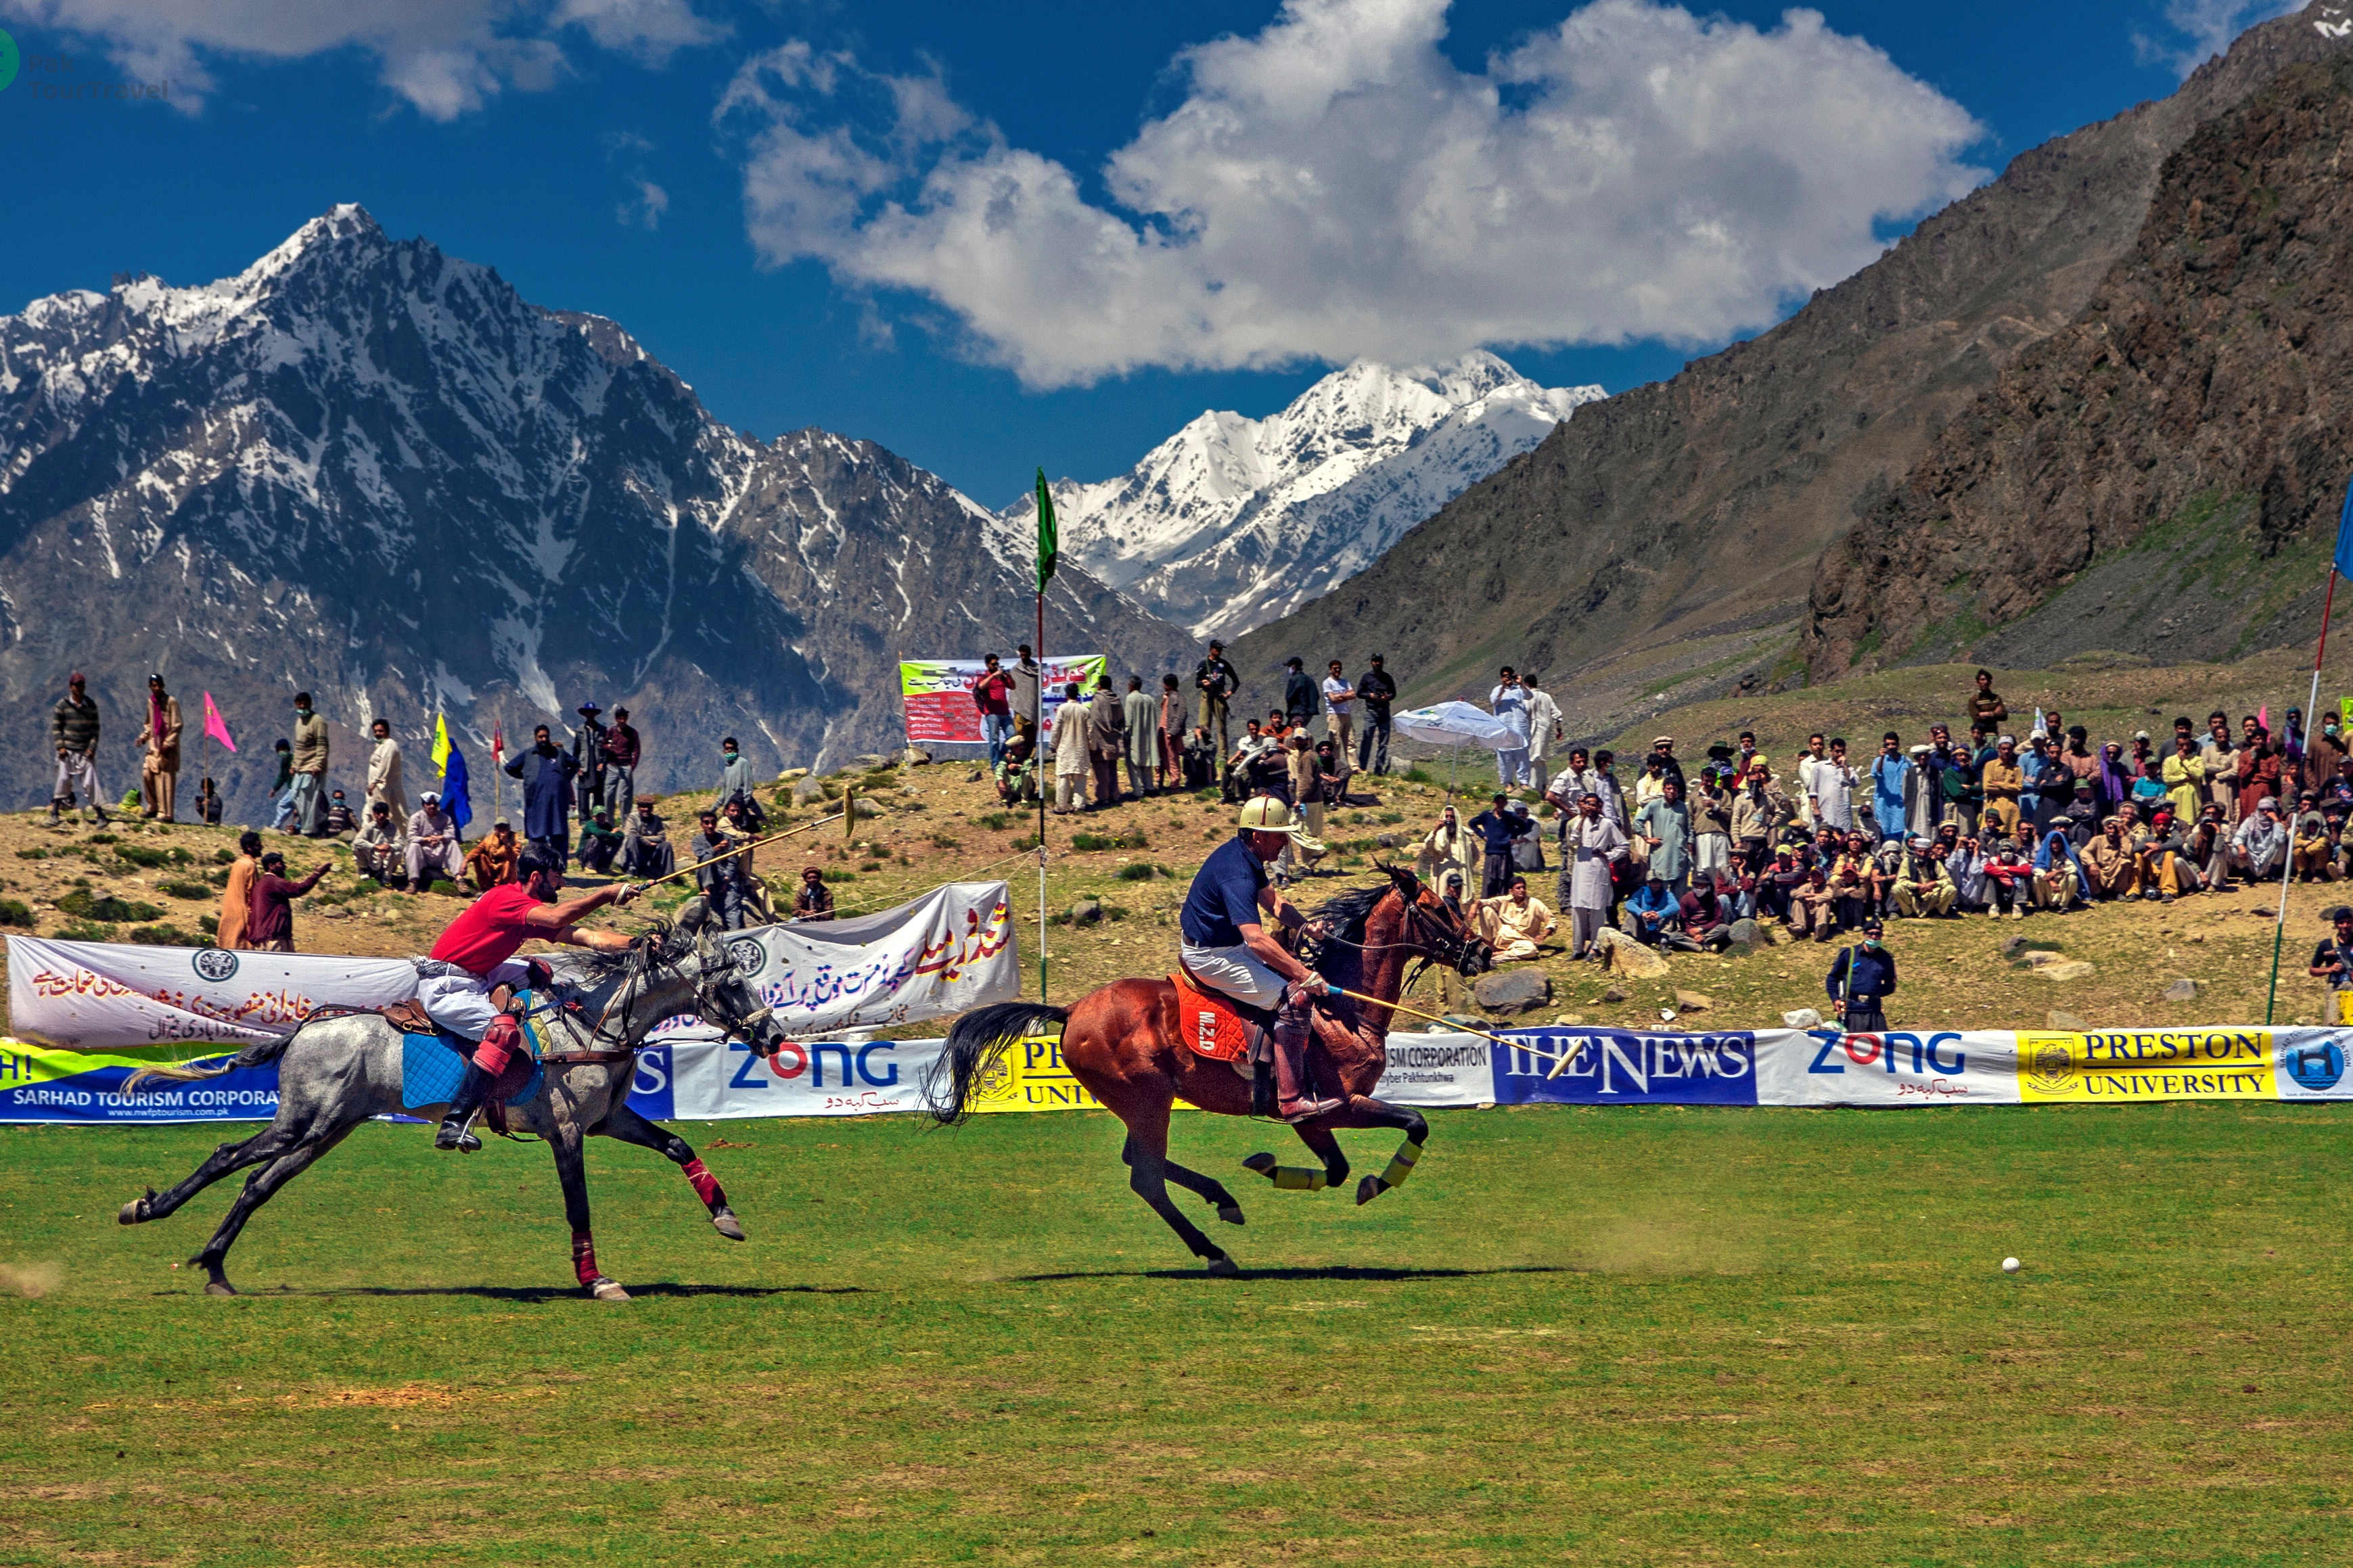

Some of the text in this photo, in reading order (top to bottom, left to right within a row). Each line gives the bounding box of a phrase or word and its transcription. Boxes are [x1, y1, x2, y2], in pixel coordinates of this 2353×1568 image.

[1497, 1034, 1597, 1078] THE
[2082, 1032, 2263, 1060] PRESTON
[1387, 1047, 1487, 1068] ISM CORPORATION
[2083, 1074, 2266, 1094] UNIVERSITY
[14, 1089, 280, 1107] SARHAD TOURISM CORPORA
